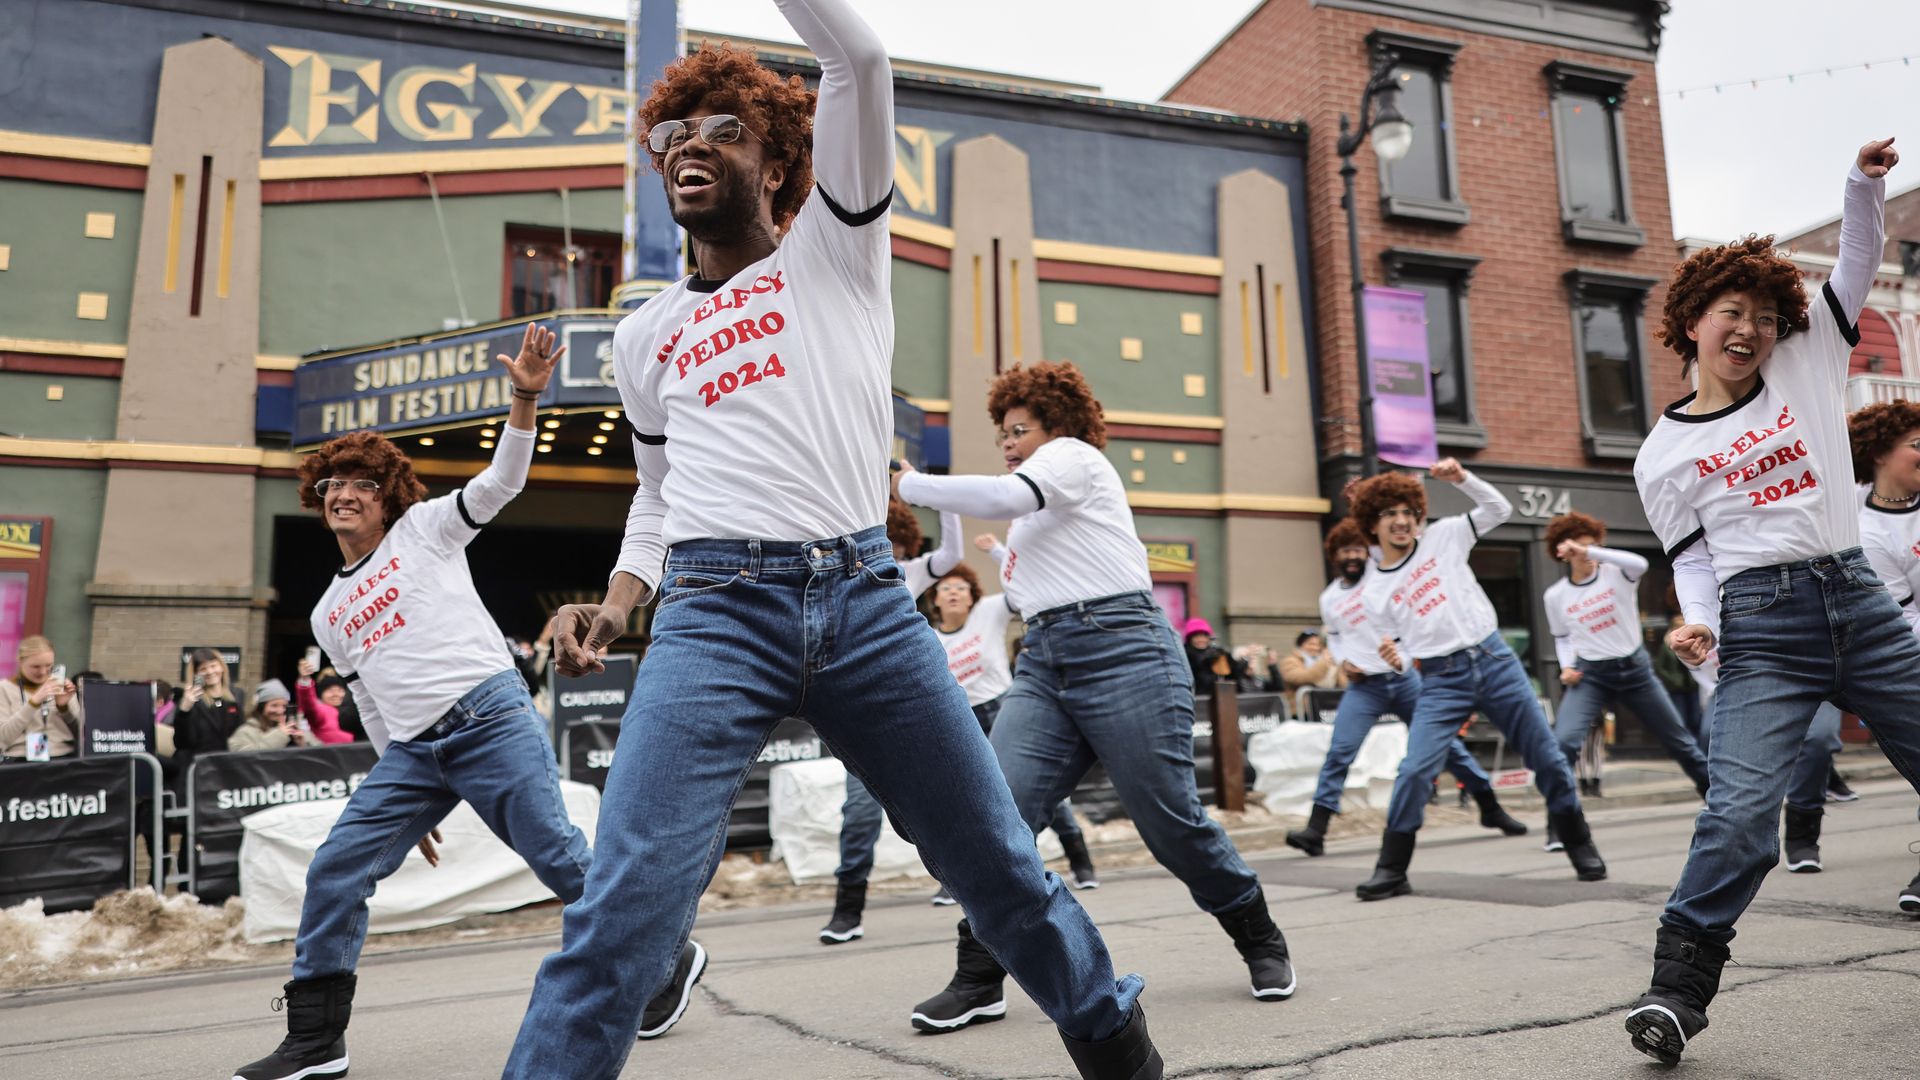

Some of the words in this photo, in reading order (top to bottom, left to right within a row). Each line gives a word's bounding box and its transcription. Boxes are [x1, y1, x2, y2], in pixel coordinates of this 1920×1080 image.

[354, 341, 490, 392] SUNDANCE
[675, 312, 784, 380] PEDRO
[698, 353, 785, 407] 2024
[321, 398, 379, 434] FILM
[390, 376, 513, 423] FESTIVAL
[1724, 439, 1808, 488] PEDRO
[1517, 485, 1570, 518] 324
[1748, 470, 1817, 507] 2024
[344, 587, 399, 639] PEDRO
[362, 611, 406, 652] 2024
[7, 790, 107, 822] festival
[217, 779, 347, 809] sundance
